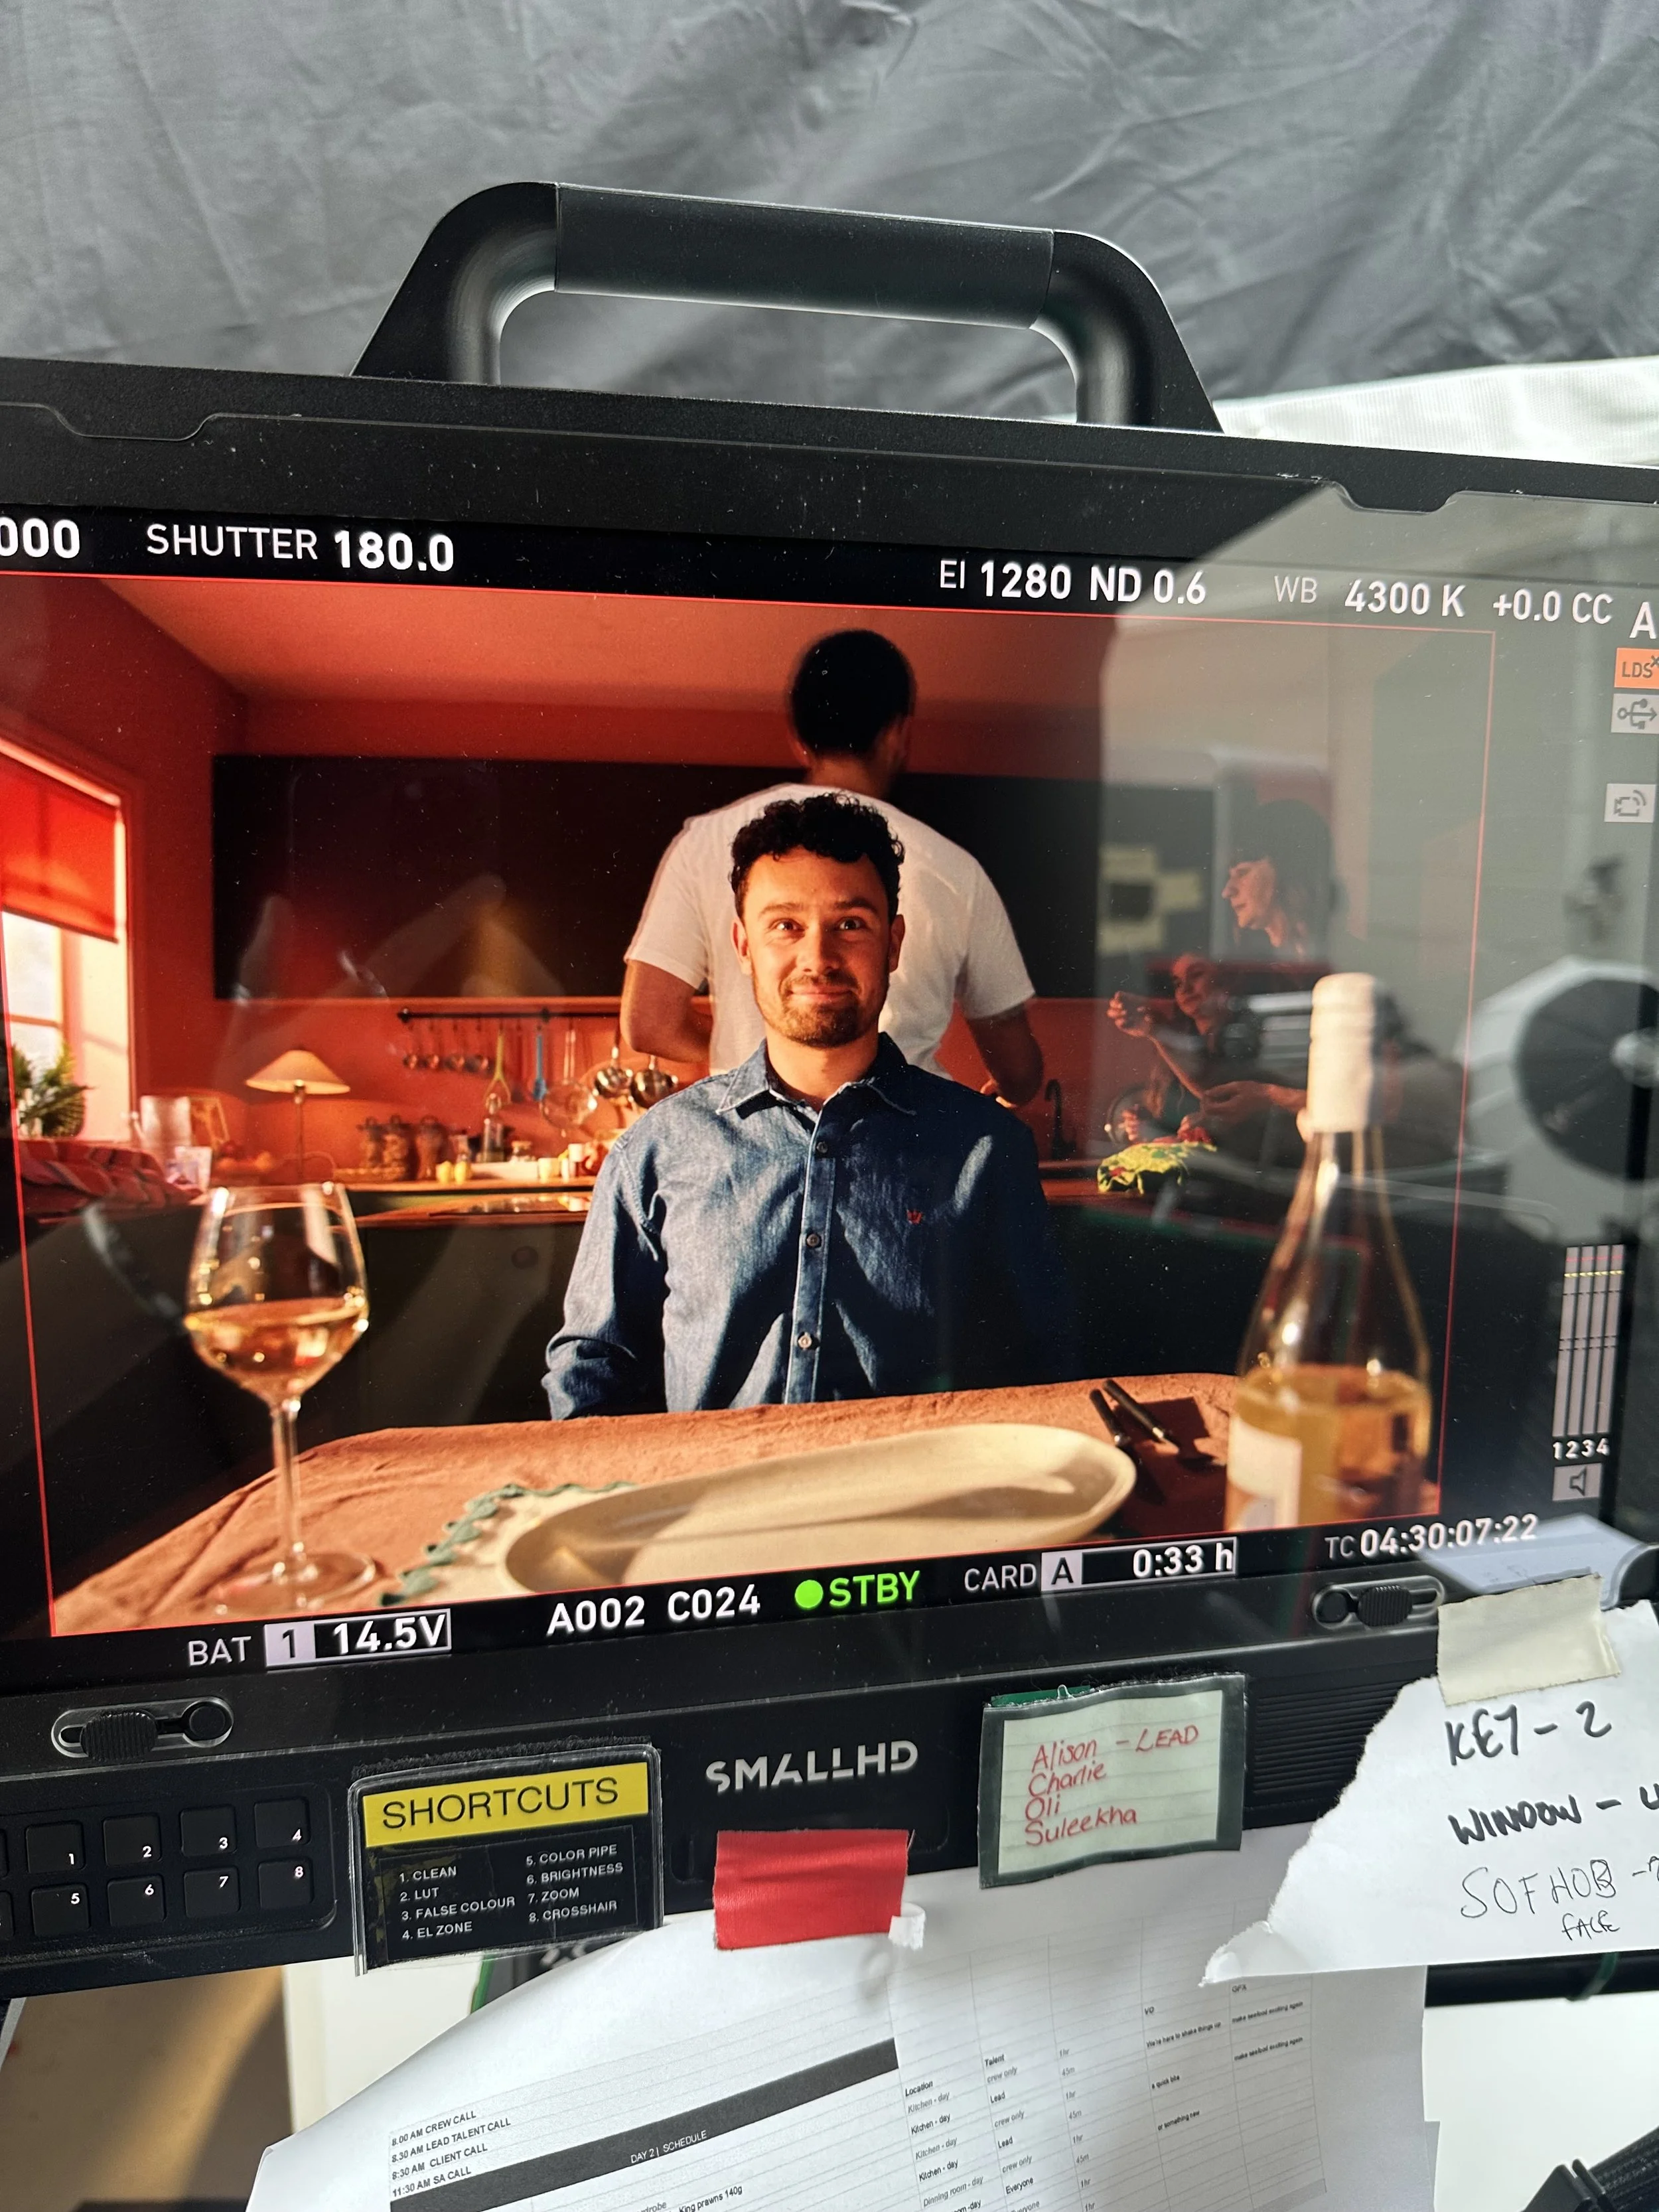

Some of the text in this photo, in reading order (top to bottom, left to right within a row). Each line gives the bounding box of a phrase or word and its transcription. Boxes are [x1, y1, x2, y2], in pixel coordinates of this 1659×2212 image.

[147, 524, 454, 572] SHUTTER 180.0
[981, 560, 1072, 599] 1280
[1090, 565, 1206, 605] ND 0.6
[1274, 575, 1657, 639] WB 4300 K +0.0 CC A
[1326, 1514, 1538, 1558] TC 04:30:07:22
[965, 1540, 1234, 1592] CARD A 0:33 h
[829, 1570, 920, 1607] STBY
[546, 1584, 760, 1637] A002 C024
[188, 1613, 446, 1666] BAT 1 14.5V
[1575, 1700, 1612, 1738] 2
[1031, 1739, 1097, 1773] Alison
[1135, 1725, 1198, 1751] LEAD
[705, 1740, 919, 1793] SMALLHD
[1029, 1761, 1107, 1797] Charlie
[383, 1777, 618, 1829] SHORTCUTS
[1025, 1795, 1060, 1821] Oli
[1025, 1806, 1137, 1846] Suleekha
[1447, 1795, 1582, 1845] WINDOW
[219, 1837, 229, 1850] 3
[293, 1829, 302, 1842] 4
[68, 1853, 74, 1865] 1
[143, 1846, 152, 1858] 2
[540, 1849, 585, 1864] COLOR
[589, 1844, 618, 1859] PIPE
[219, 1876, 229, 1888] 7
[294, 1866, 303, 1878] 8
[413, 1866, 457, 1881] CLEAN
[541, 1862, 624, 1883] BRIGHTNESS
[70, 1893, 80, 1904] 5
[145, 1884, 154, 1896] 6
[415, 1887, 439, 1900] LUT
[541, 1887, 579, 1902] ZOOM
[416, 1904, 457, 1920] FALSE
[461, 1896, 516, 1914] COLOUR
[543, 1899, 618, 1921] CROSSHAIR
[417, 1926, 434, 1939] EL
[437, 1921, 473, 1937] ZONE
[1145, 2006, 1155, 2015] VO
[985, 2053, 1005, 2067] Talent
[987, 2066, 1018, 2084] crew only
[905, 2080, 933, 2097] Location
[990, 2091, 1005, 2104] Lead
[908, 2091, 950, 2114] Kitchen day
[410, 2128, 423, 2140] AM
[425, 2118, 451, 2134] CREW
[453, 2110, 476, 2124] CALL
[911, 2114, 950, 2134] Kitchen day
[995, 2110, 1025, 2128] crew only
[1068, 2110, 1082, 2120] 45m
[410, 2145, 423, 2156] AM
[426, 2136, 449, 2151] LEAD
[451, 2124, 486, 2142] TALENT
[488, 2118, 511, 2131] CALL
[630, 2150, 647, 2164] DAY
[663, 2130, 707, 2152] SCHEDULE
[998, 2135, 1013, 2149] Lead
[411, 2162, 425, 2174] AM
[430, 2150, 461, 2167] CLIENT
[464, 2143, 488, 2156] CALL
[916, 2137, 958, 2160] Kitchen day
[1076, 2154, 1089, 2164] 45m
[919, 2160, 958, 2181] Kitchen day
[1002, 2155, 1033, 2174] crew only
[393, 2166, 471, 2197] 11:30 AM SA CALL
[950, 2183, 967, 2196] room
[972, 2175, 983, 2185] day
[1006, 2176, 1034, 2195] Everyone
[697, 2193, 723, 2211] prawns
[725, 2186, 743, 2197] 140g
